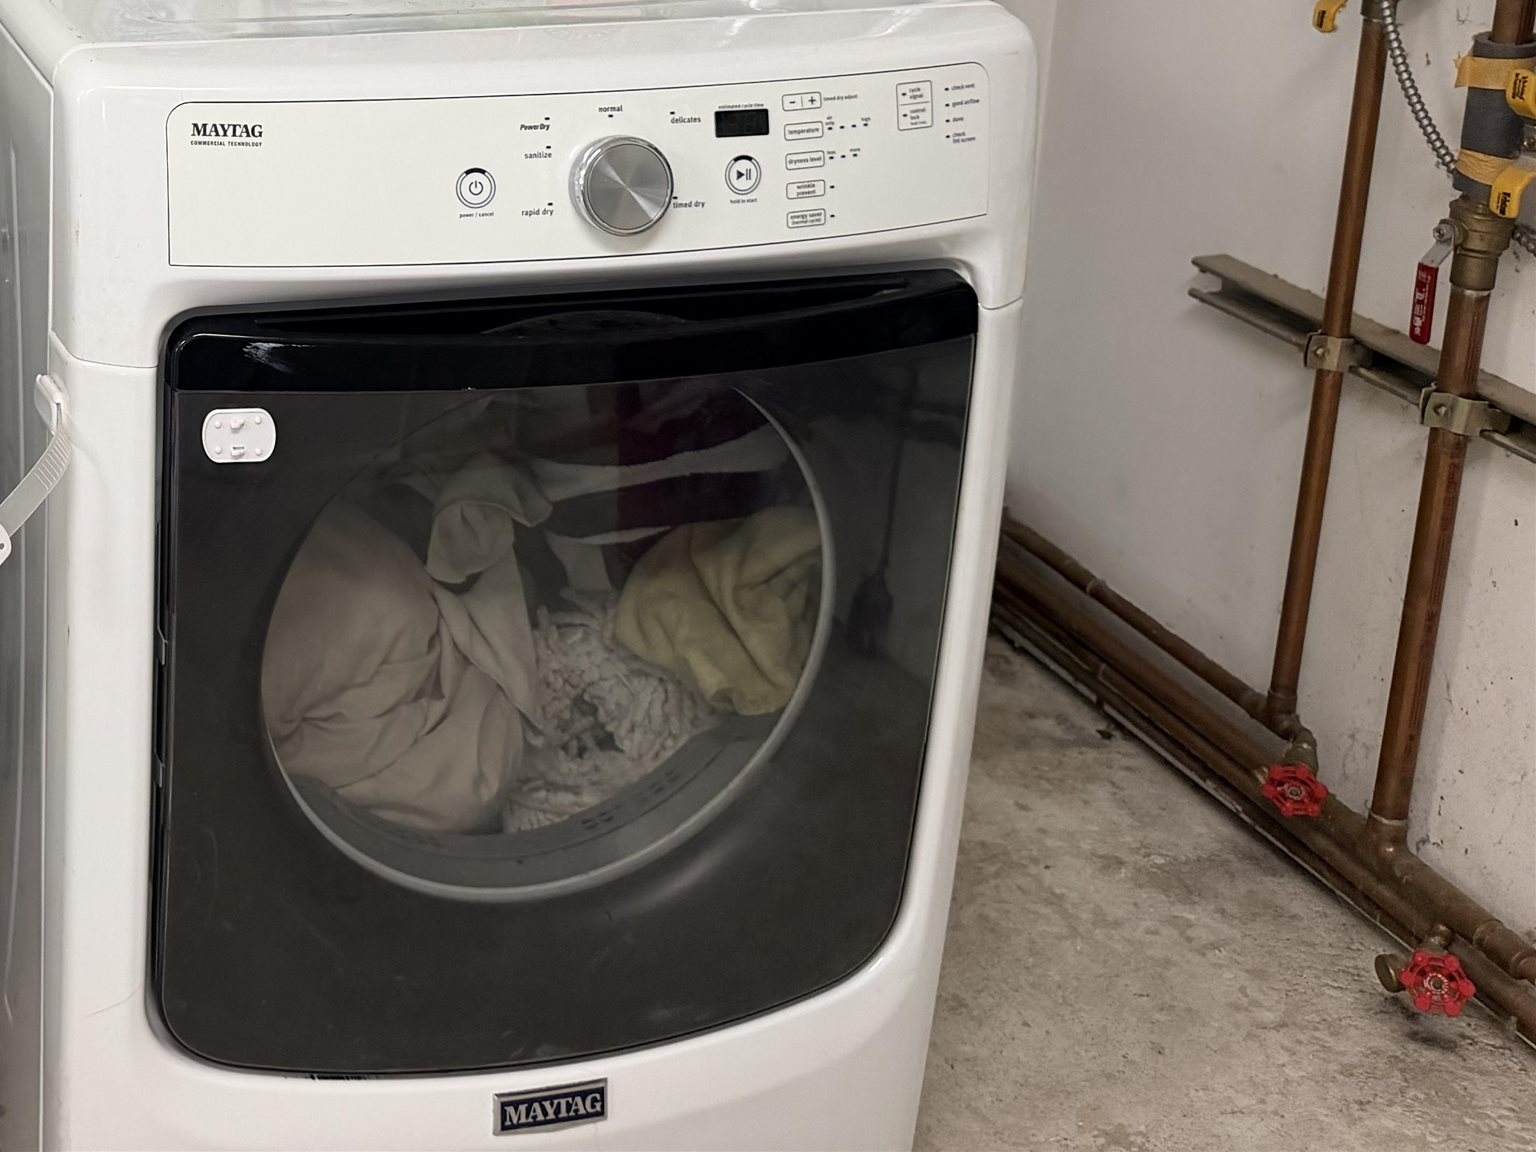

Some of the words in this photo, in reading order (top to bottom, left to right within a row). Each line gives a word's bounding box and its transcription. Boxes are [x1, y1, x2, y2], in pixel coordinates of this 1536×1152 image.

[191, 123, 263, 138] MAYTAG
[694, 200, 705, 208] dry
[542, 208, 553, 216] dry
[504, 1093, 602, 1125] MAYTAG
